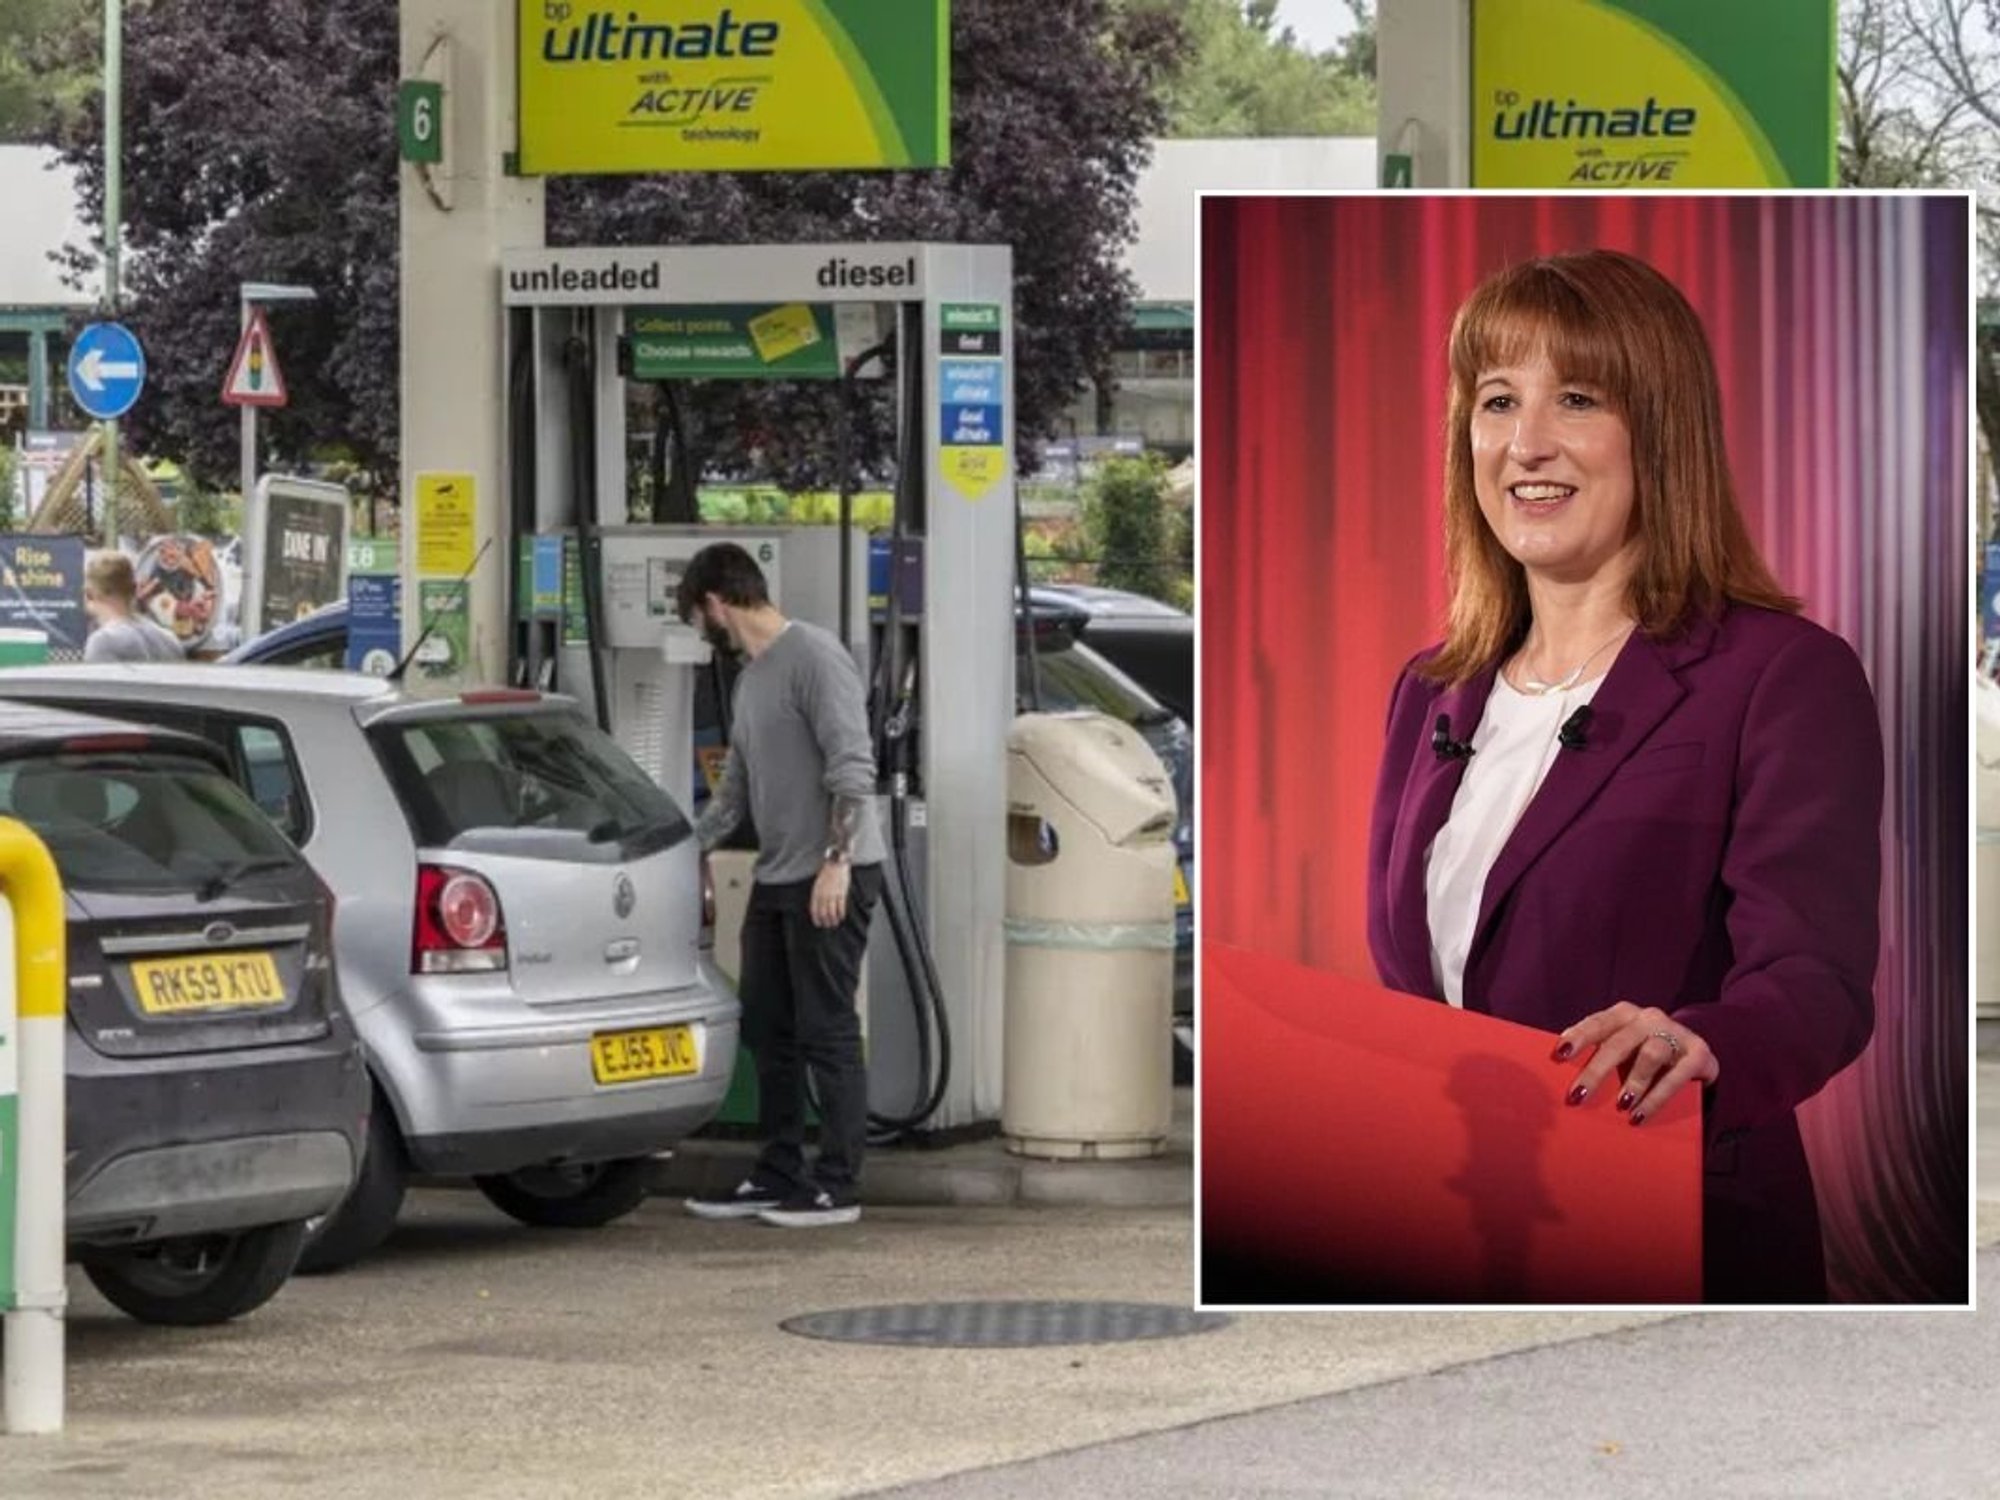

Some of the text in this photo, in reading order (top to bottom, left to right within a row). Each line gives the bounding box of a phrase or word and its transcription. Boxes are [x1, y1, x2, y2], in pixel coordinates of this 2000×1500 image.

[544, 9, 778, 61] ultimate
[638, 70, 671, 83] with
[629, 87, 757, 114] ACTIVE
[414, 96, 431, 141] 6
[1494, 97, 1696, 139] ultimate
[682, 125, 760, 142] technology
[1569, 160, 1677, 181] ACTIVE
[510, 262, 660, 291] unleaded
[817, 257, 915, 287] diesel
[15, 546, 51, 567] Rise
[759, 543, 773, 562] 6
[149, 962, 272, 1004] RK59 XTU
